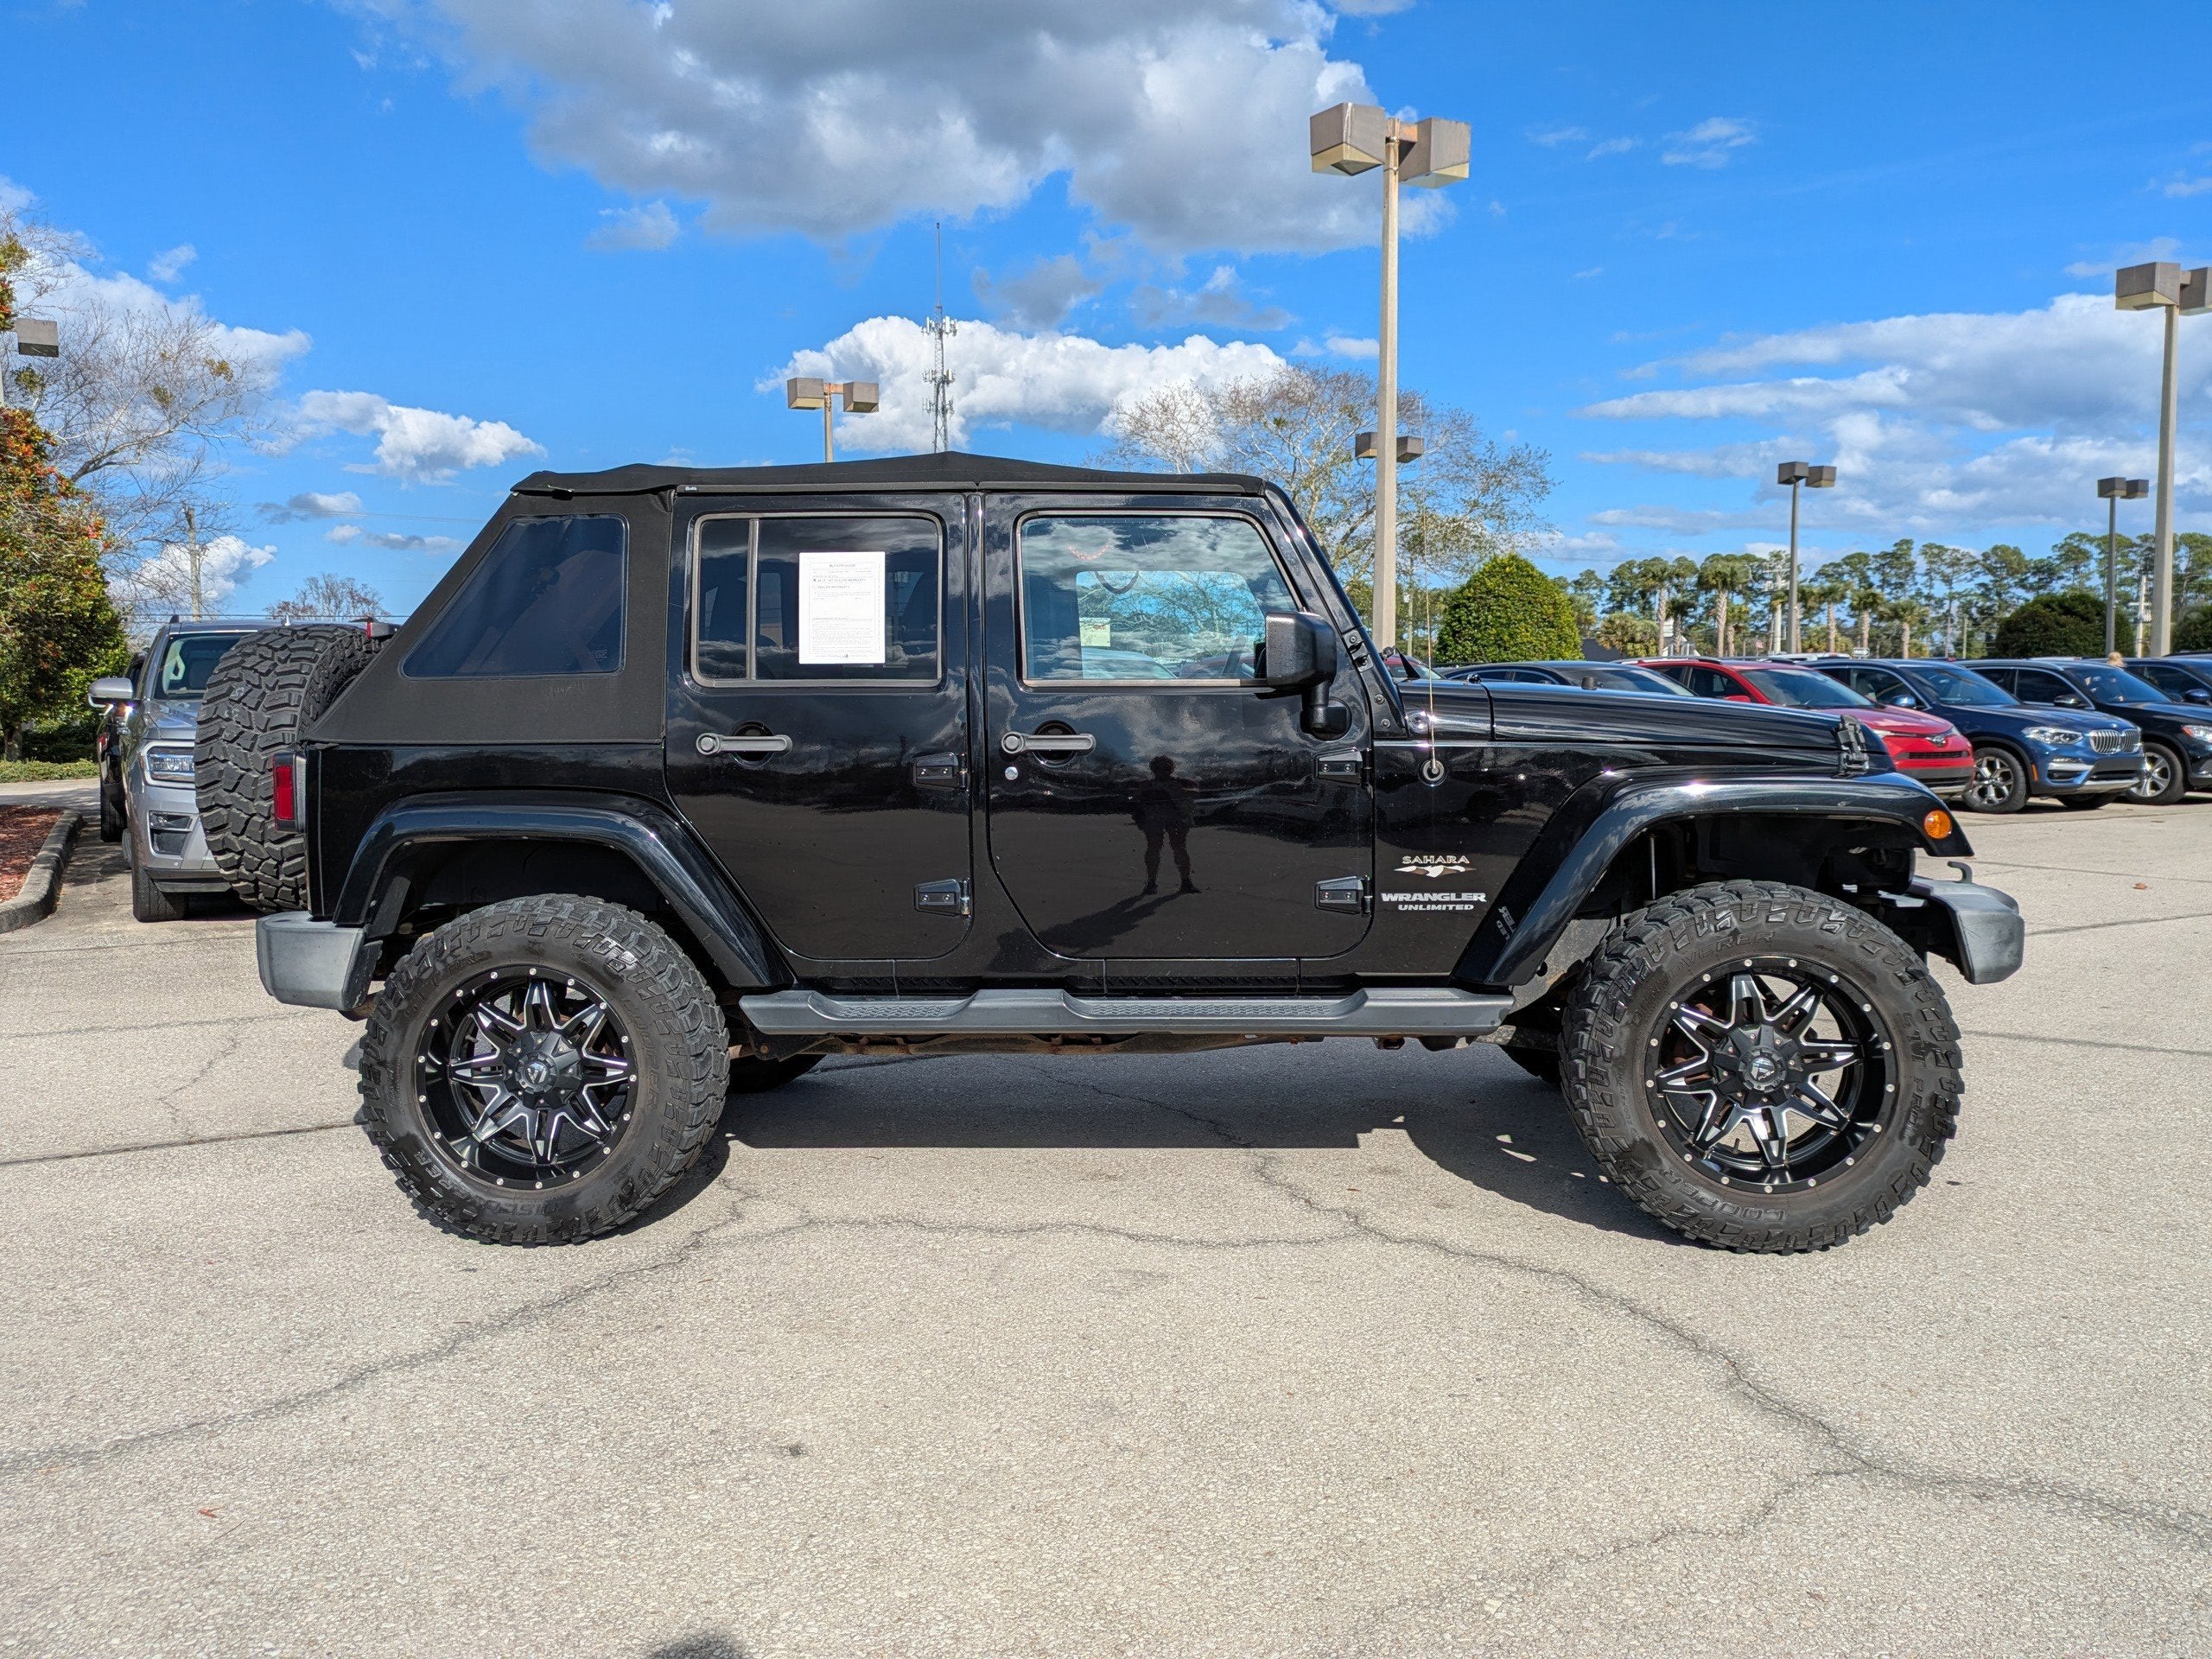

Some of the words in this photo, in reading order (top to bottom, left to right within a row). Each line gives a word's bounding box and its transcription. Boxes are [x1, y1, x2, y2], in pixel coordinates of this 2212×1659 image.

[1402, 855, 1470, 864] SAHARA
[1381, 893, 1487, 902] WRANGLER
[1659, 1168, 1786, 1222] COOPER
